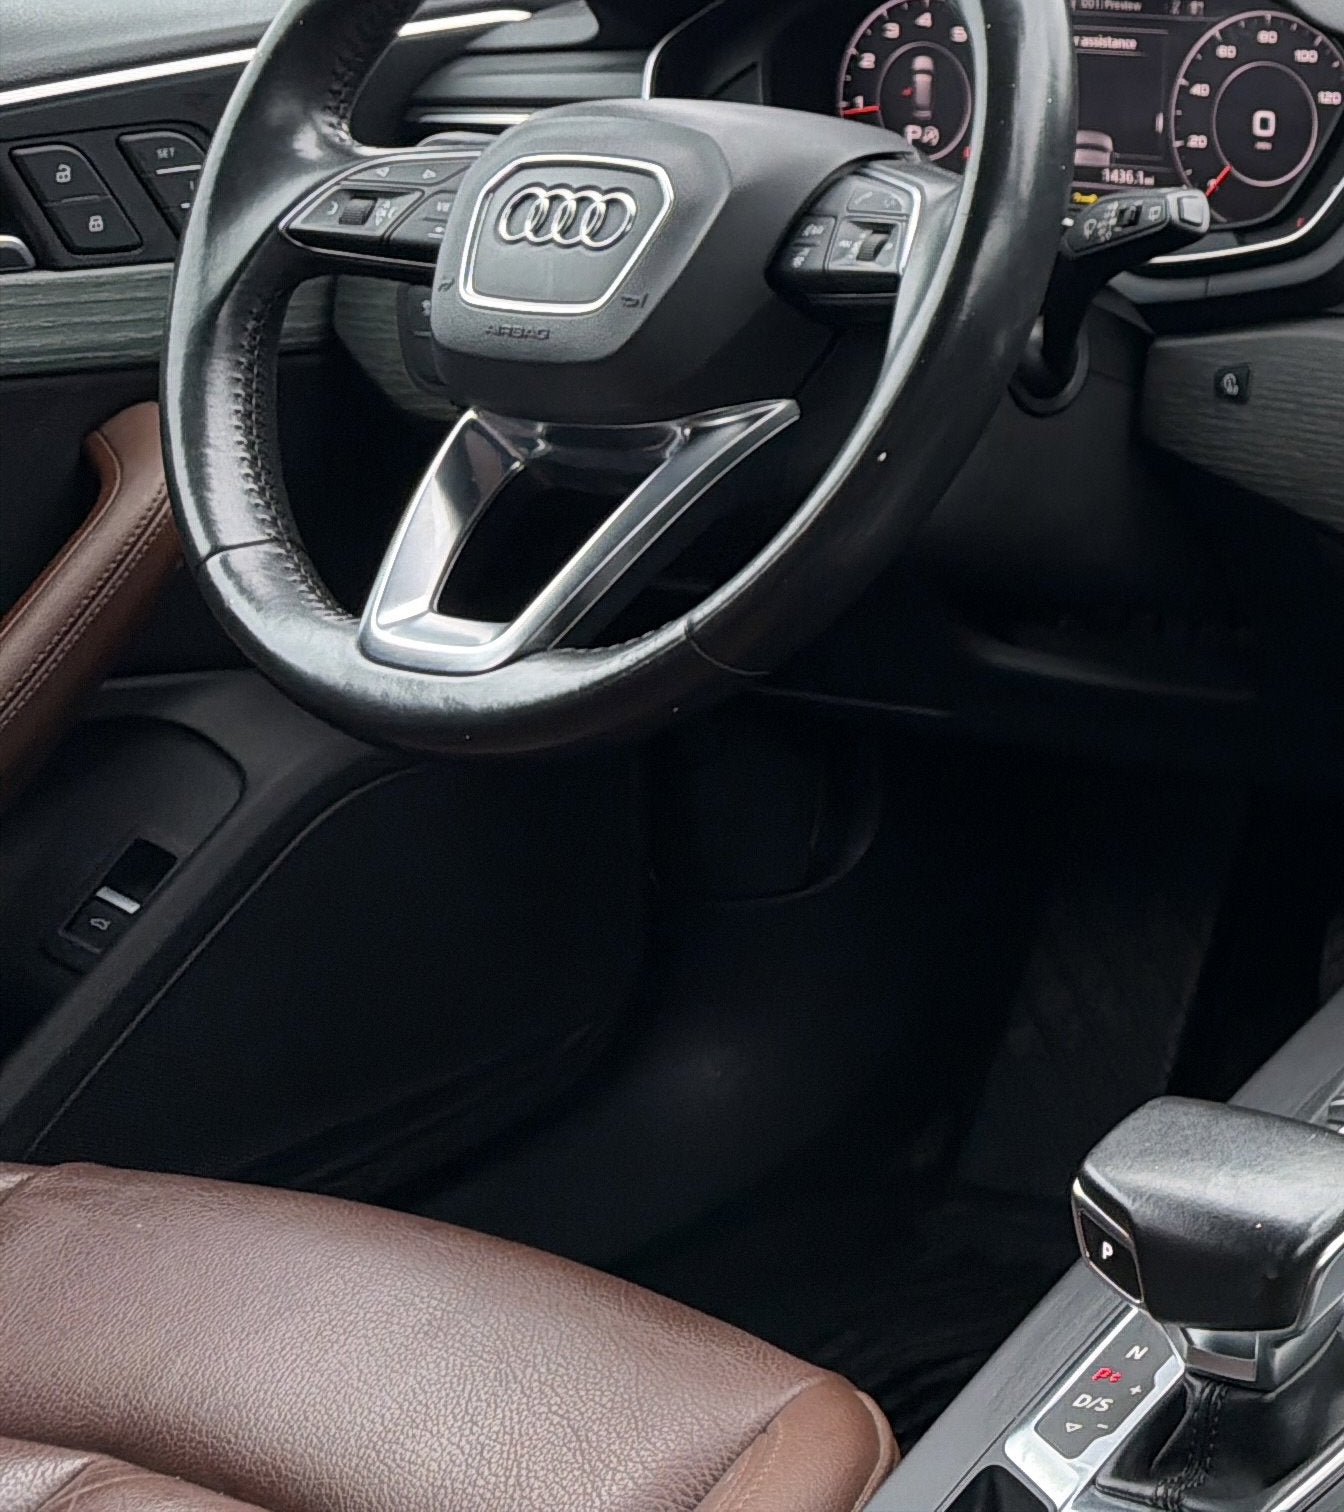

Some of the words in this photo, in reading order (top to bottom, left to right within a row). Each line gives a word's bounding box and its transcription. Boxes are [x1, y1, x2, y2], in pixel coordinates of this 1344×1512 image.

[914, 11, 932, 29] 4
[882, 22, 900, 39] 3
[949, 25, 968, 43] 5
[1256, 30, 1279, 44] 80
[1080, 34, 1138, 51] assistance
[858, 51, 877, 69] 2
[1293, 48, 1319, 64] 100
[1188, 82, 1210, 98] 40
[1317, 90, 1342, 105] 120
[1252, 109, 1276, 138] 0
[1186, 134, 1208, 149] 20
[156, 146, 176, 160] SET
[485, 324, 551, 341] AIRBAG
[1101, 1240, 1113, 1261] P
[1125, 1345, 1149, 1360] N
[1071, 1392, 1114, 1413] D/S
